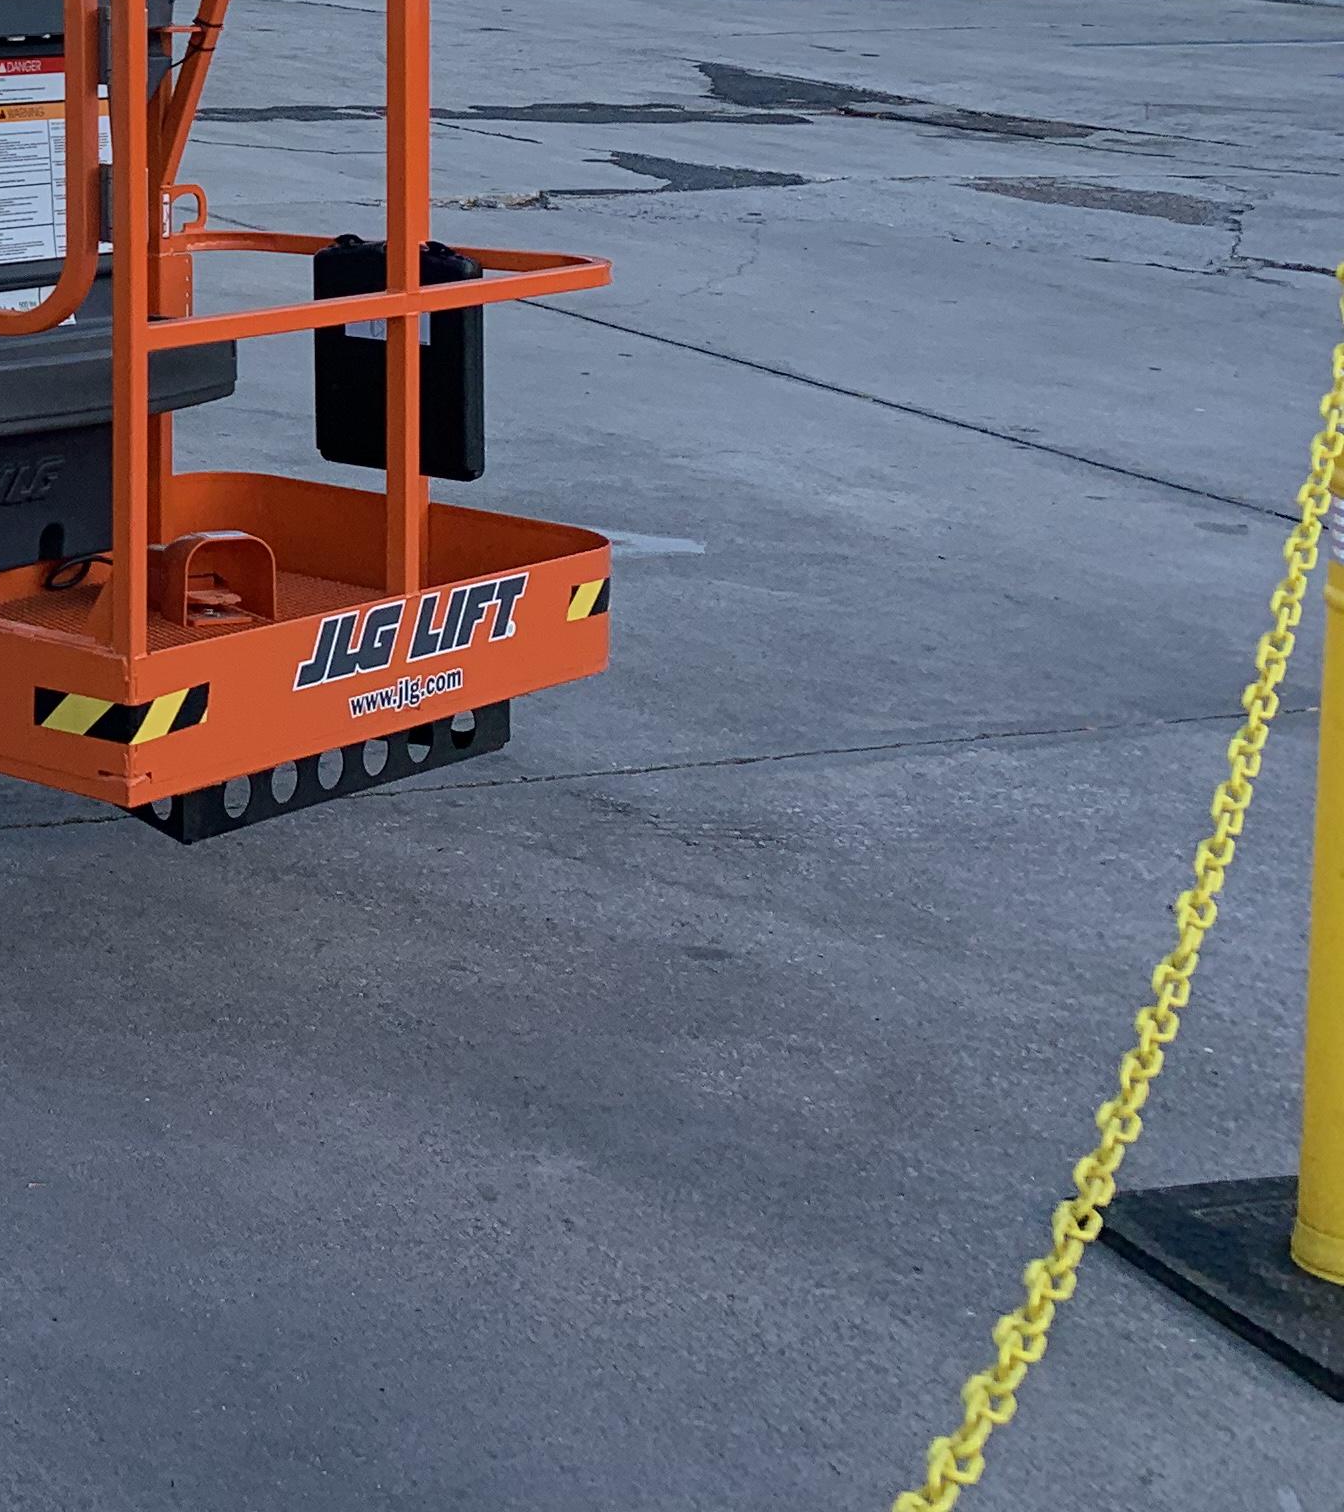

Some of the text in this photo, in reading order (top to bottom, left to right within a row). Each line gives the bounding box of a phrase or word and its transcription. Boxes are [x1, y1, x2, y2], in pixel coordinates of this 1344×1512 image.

[7, 60, 42, 73] DANGER
[8, 106, 46, 118] WARNING
[292, 572, 530, 691] JLG LIFT
[349, 668, 463, 719] www.jlg.com
